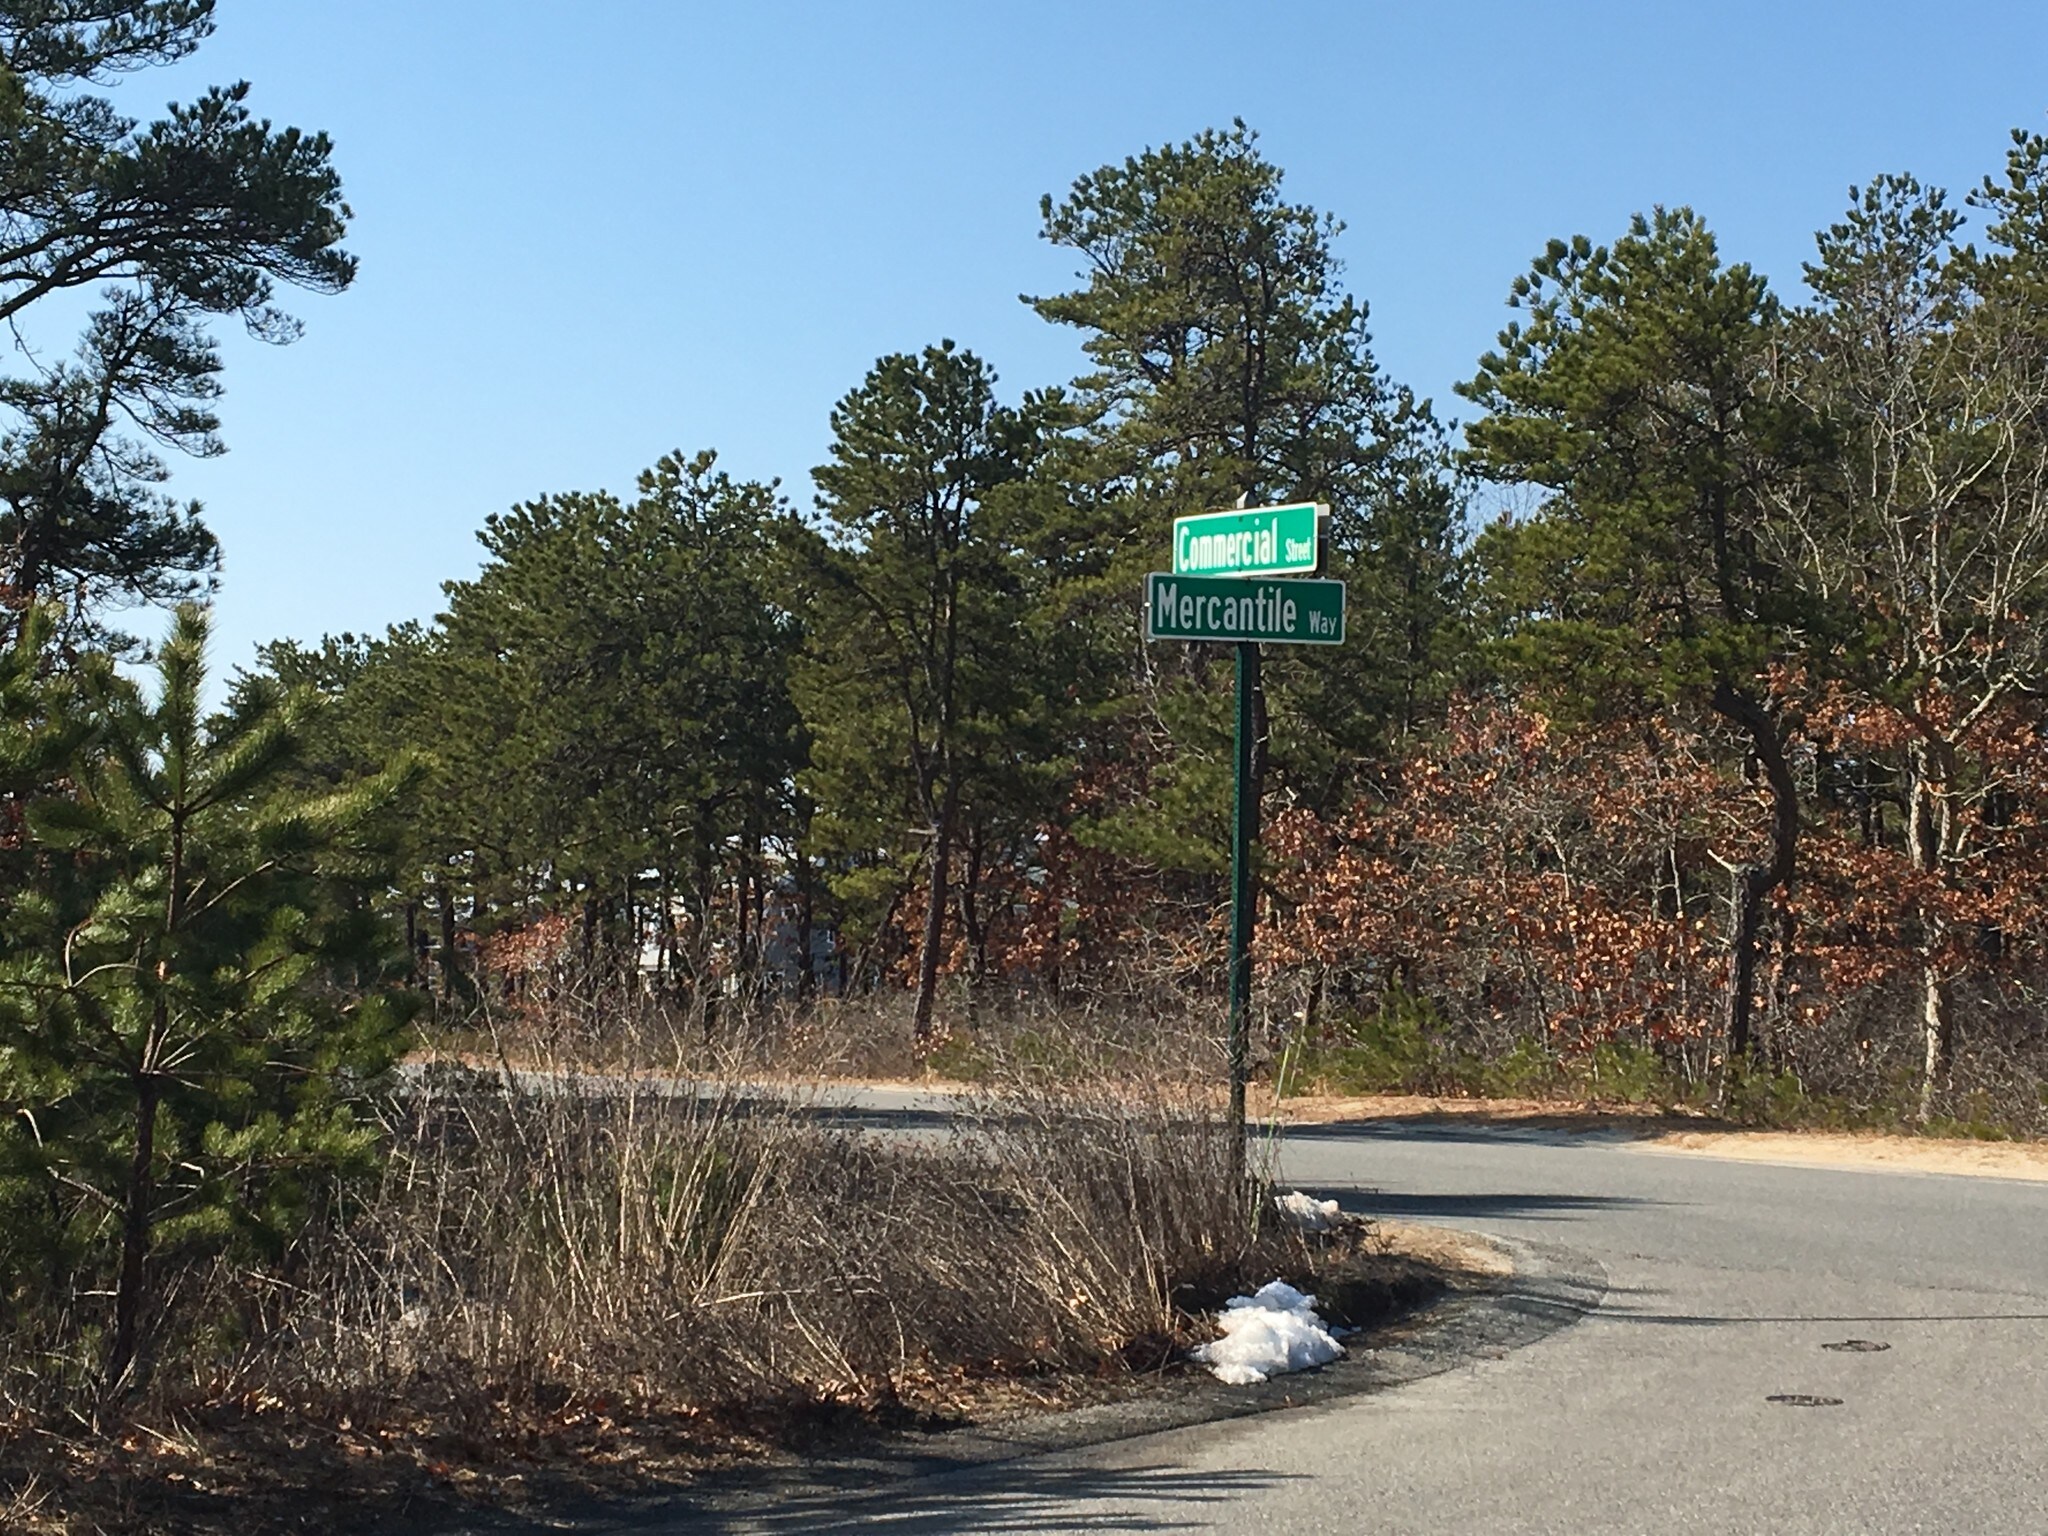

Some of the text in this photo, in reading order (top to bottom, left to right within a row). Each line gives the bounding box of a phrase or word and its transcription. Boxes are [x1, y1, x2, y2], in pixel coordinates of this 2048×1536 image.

[1178, 517, 1312, 572] Commercial Street
[1157, 582, 1337, 636] Mercantile Way
